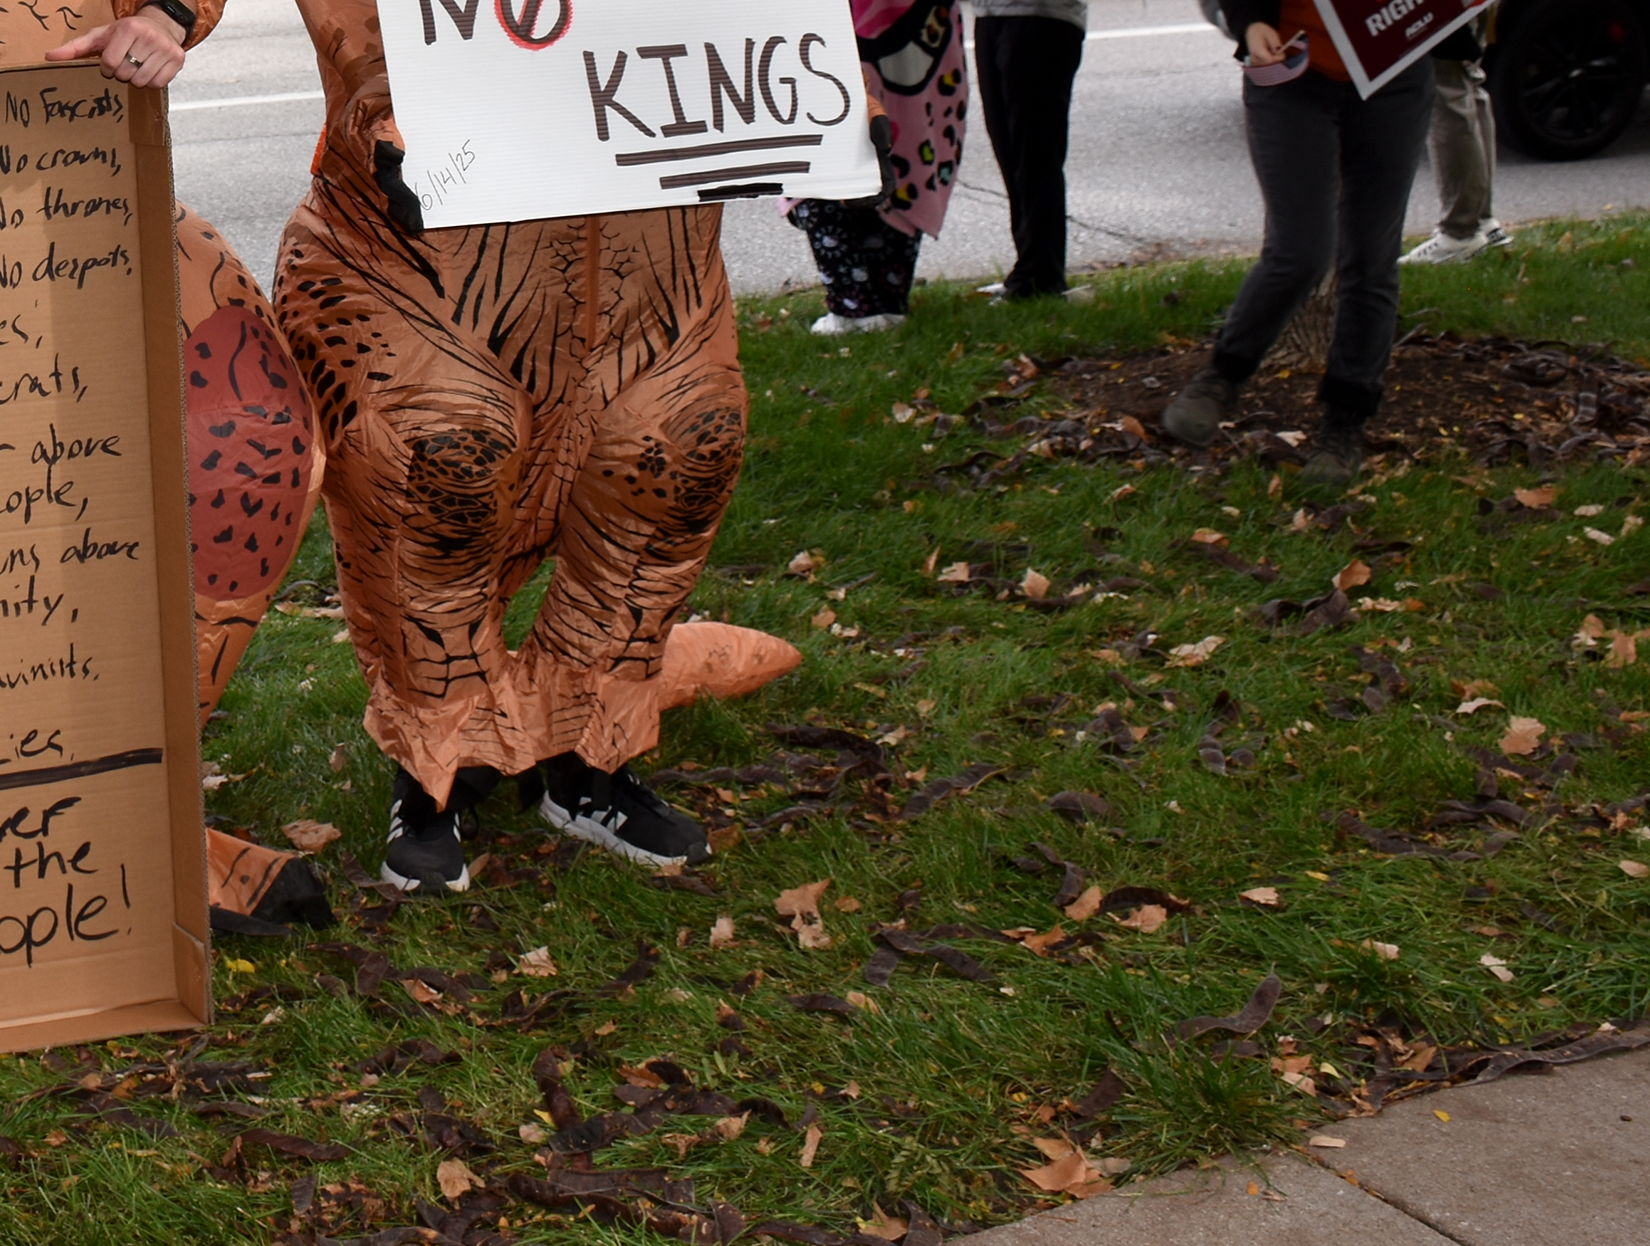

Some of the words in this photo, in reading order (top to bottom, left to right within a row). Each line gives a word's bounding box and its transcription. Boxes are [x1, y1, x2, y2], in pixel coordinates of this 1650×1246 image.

[1405, 12, 1434, 38] ACLU
[582, 33, 850, 141] KINGS
[5, 90, 30, 128] No
[414, 139, 475, 211] 6/14/25
[36, 186, 133, 227] thrones,
[30, 423, 123, 468] above
[59, 528, 140, 564] above
[3, 841, 99, 889] the
